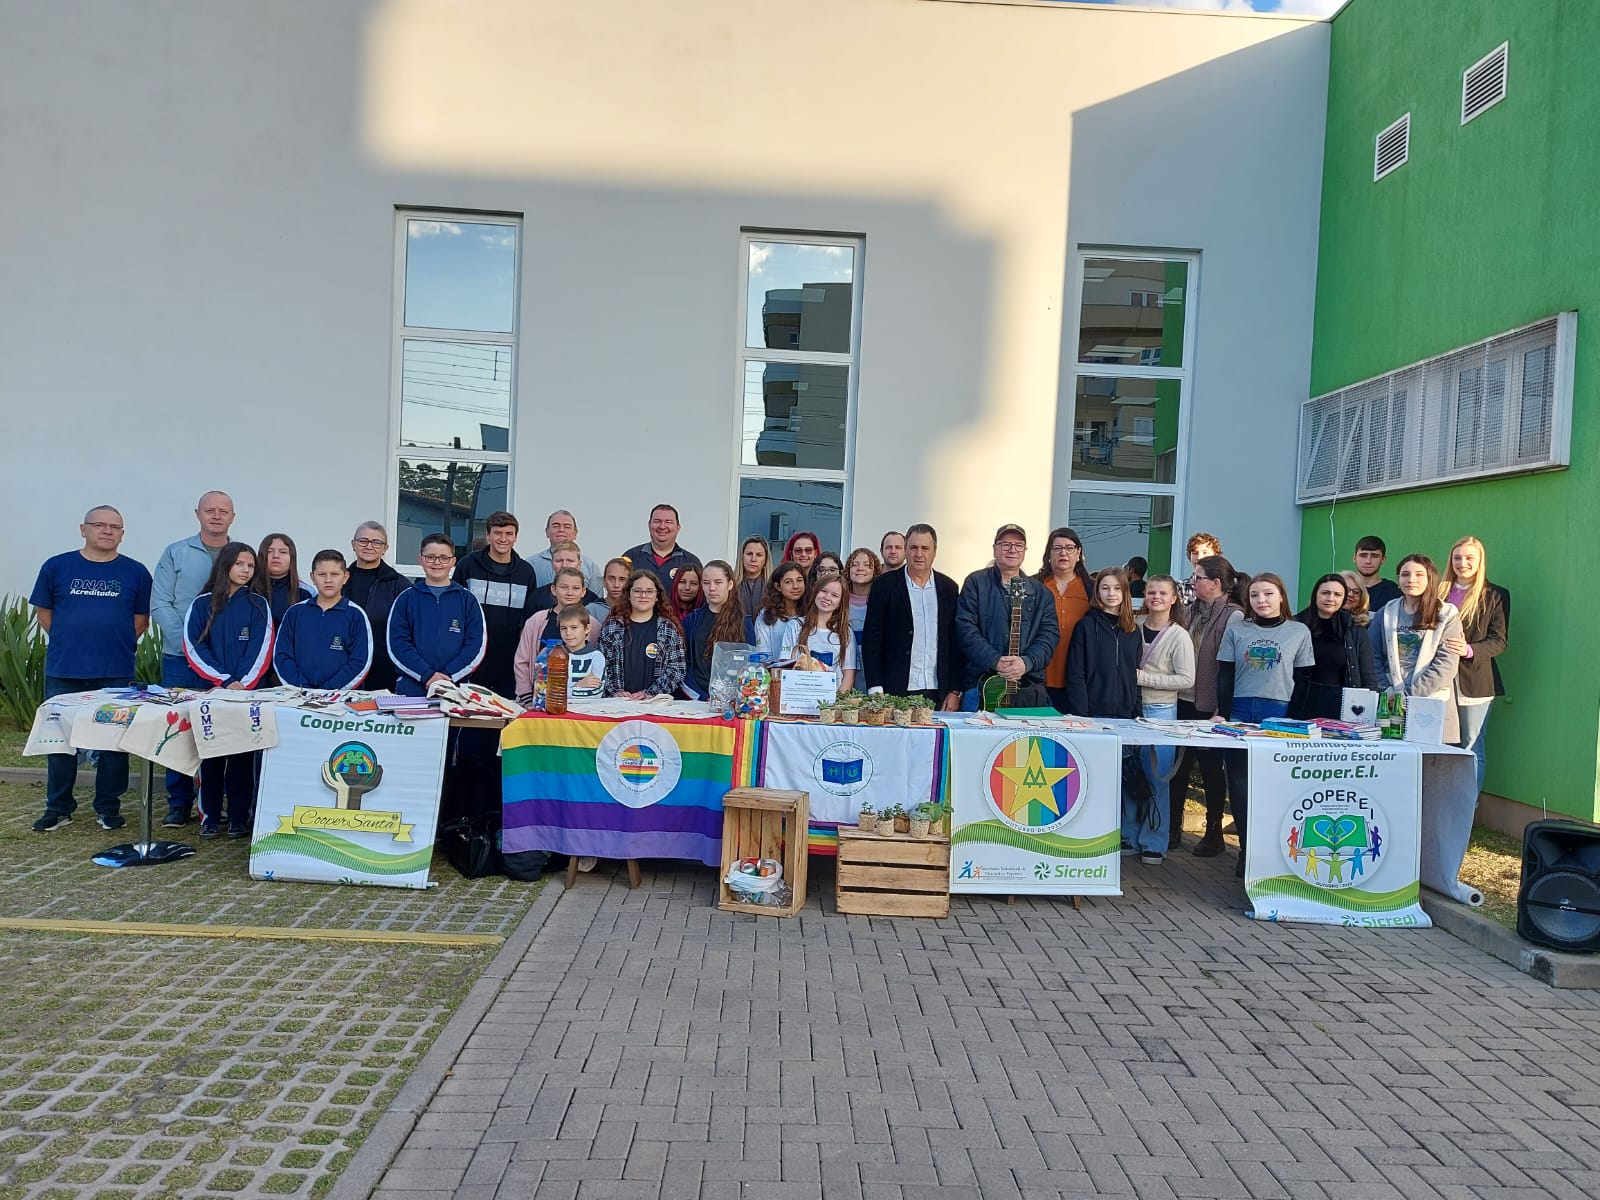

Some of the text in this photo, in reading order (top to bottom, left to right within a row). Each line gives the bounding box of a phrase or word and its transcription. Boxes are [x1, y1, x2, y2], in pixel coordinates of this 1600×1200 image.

[70, 579, 107, 591] DNA
[70, 588, 120, 597] Acreditador
[300, 714, 415, 736] CooperSanta
[1273, 751, 1397, 765] Cooperativa Escolar
[1291, 765, 1379, 782] Cooper.E.I.
[299, 809, 396, 829] CooperSanta
[1054, 864, 1108, 879] Sicredi
